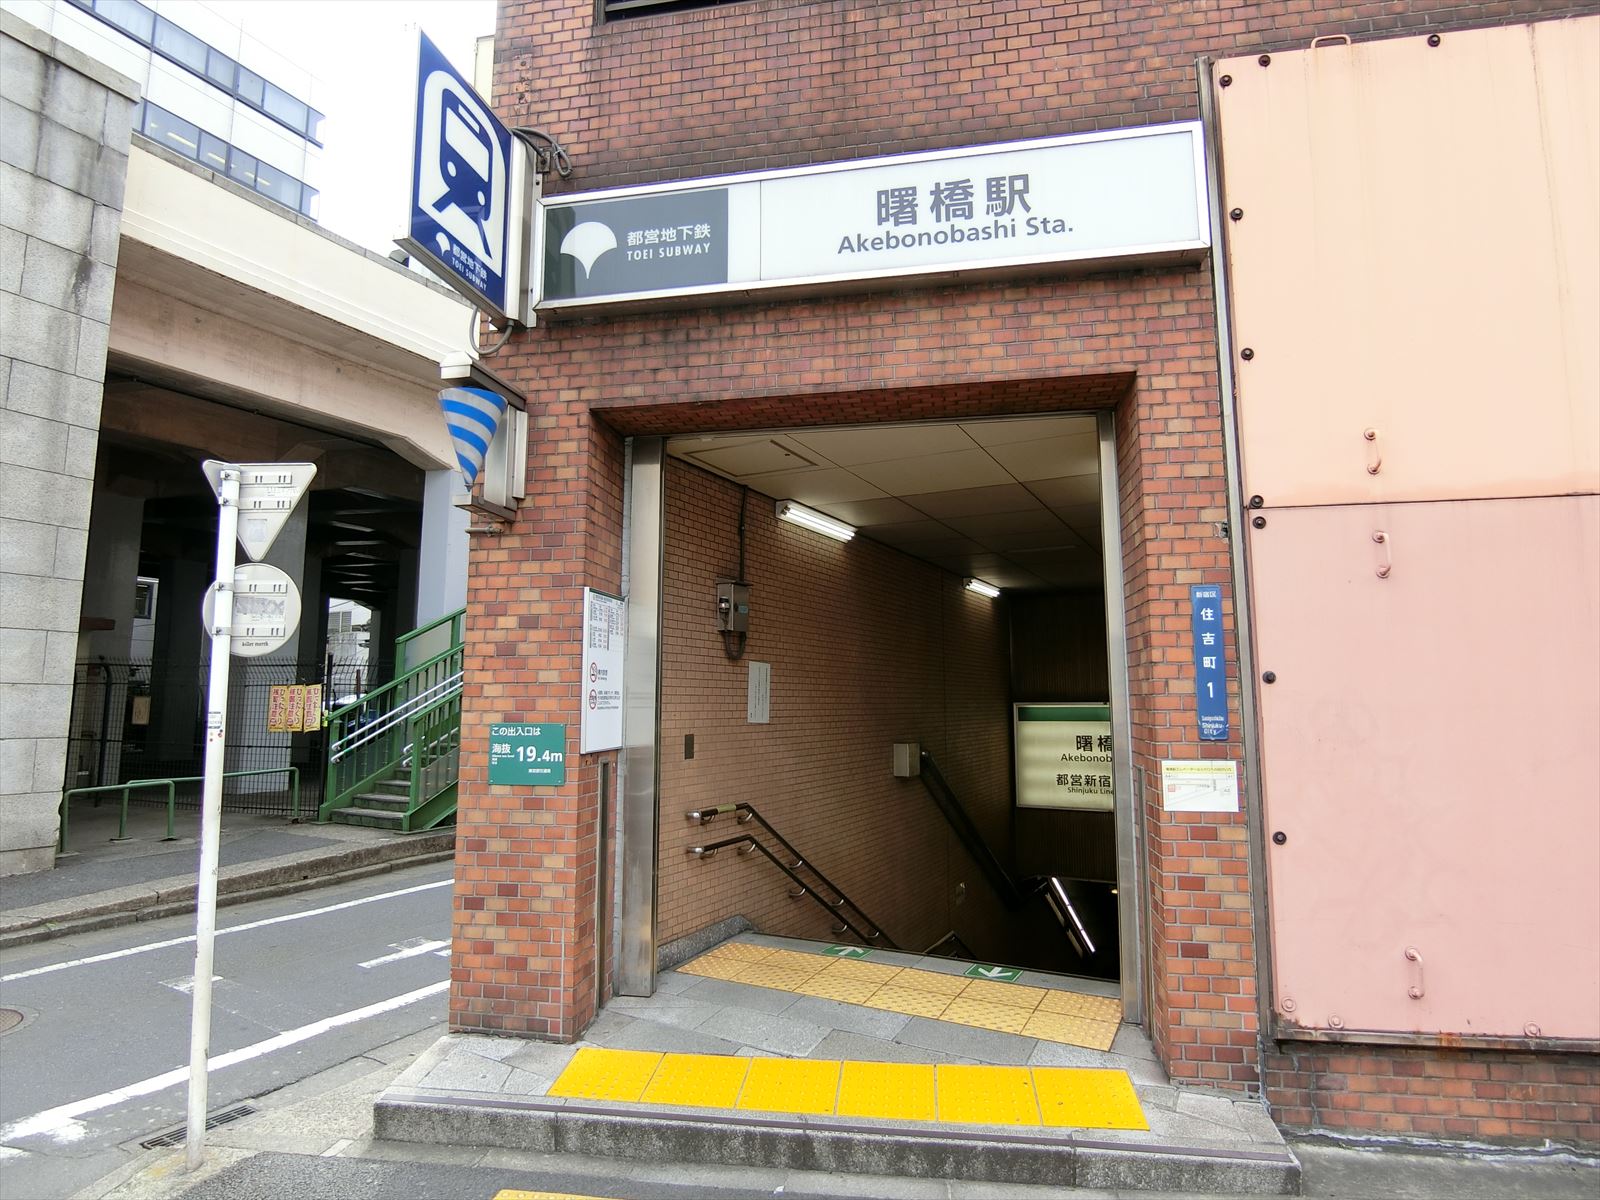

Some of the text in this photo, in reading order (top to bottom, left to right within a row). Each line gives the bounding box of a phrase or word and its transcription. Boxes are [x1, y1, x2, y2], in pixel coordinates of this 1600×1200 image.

[876, 173, 1032, 227] 曙橋駅
[626, 223, 711, 247] 都営地下鉄
[837, 216, 1074, 255] Akebonobashi Sta.
[626, 242, 711, 261] TOEI SUBWAY
[451, 256, 487, 291] TOEI SUBWAY
[491, 727, 541, 736] この出入口は
[492, 743, 563, 762] 海抜 19.4m
[1056, 774, 1111, 787] 都営新宿
[1067, 787, 1098, 795] Shinjuku
